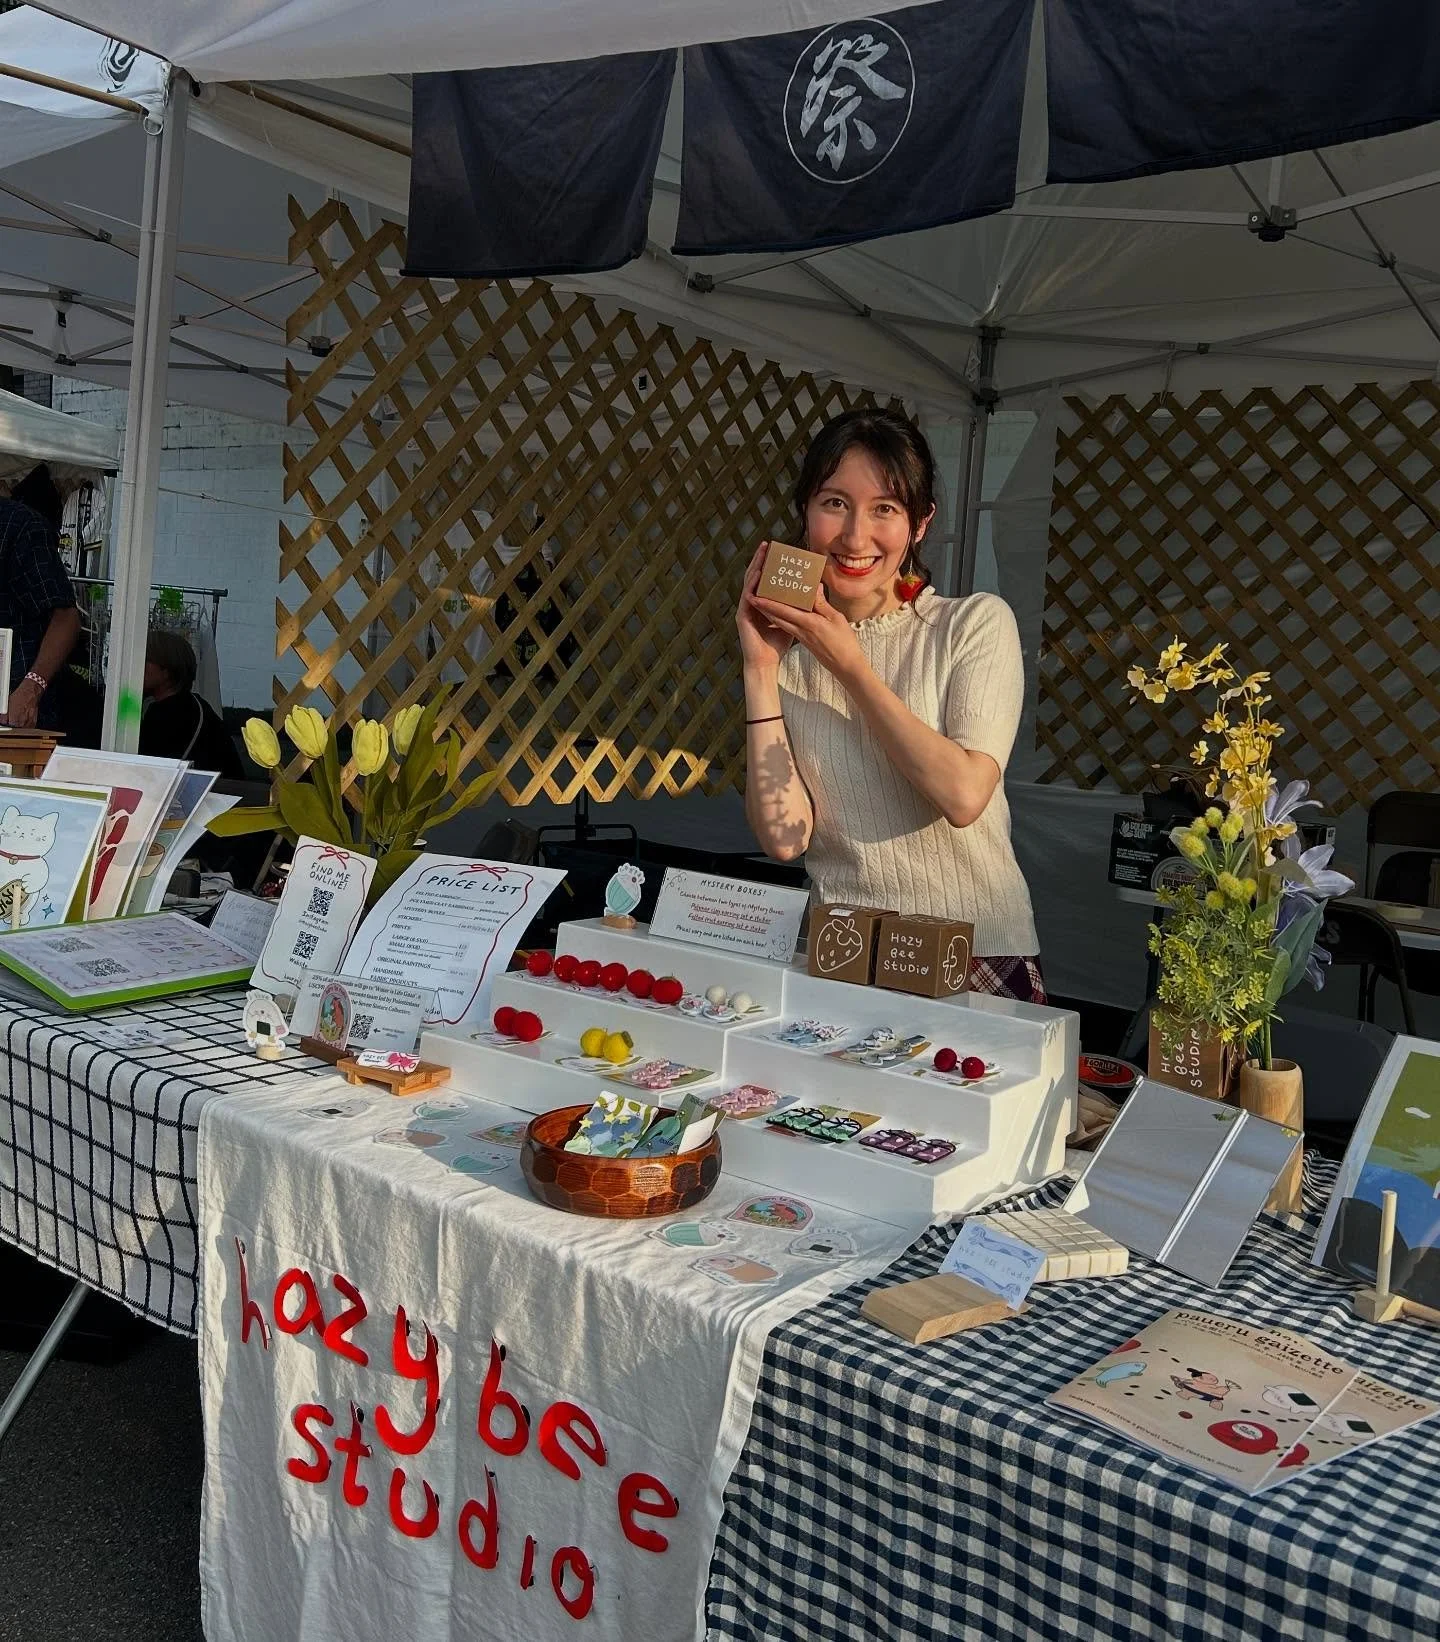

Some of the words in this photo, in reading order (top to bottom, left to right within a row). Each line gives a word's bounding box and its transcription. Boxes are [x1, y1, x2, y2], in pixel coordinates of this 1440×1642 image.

[800, 34, 906, 171] 祭
[780, 554, 811, 569] Hazy
[1130, 822, 1153, 833] GOLDEN
[309, 871, 347, 891] ONLINE!
[311, 862, 333, 875] FIND
[336, 872, 351, 883] ME
[427, 876, 477, 889] PRICE
[482, 882, 521, 895] LIST
[700, 879, 734, 892] MYSTERY
[737, 885, 767, 897] BOXES!
[890, 932, 923, 948] Hazy
[1089, 1058, 1121, 1074] GORILLA
[1174, 1311, 1250, 1338] paueru
[1254, 1334, 1345, 1376] gaizette
[235, 1236, 440, 1455] hazy
[478, 1330, 680, 1553] bee
[287, 1401, 595, 1620] studio
